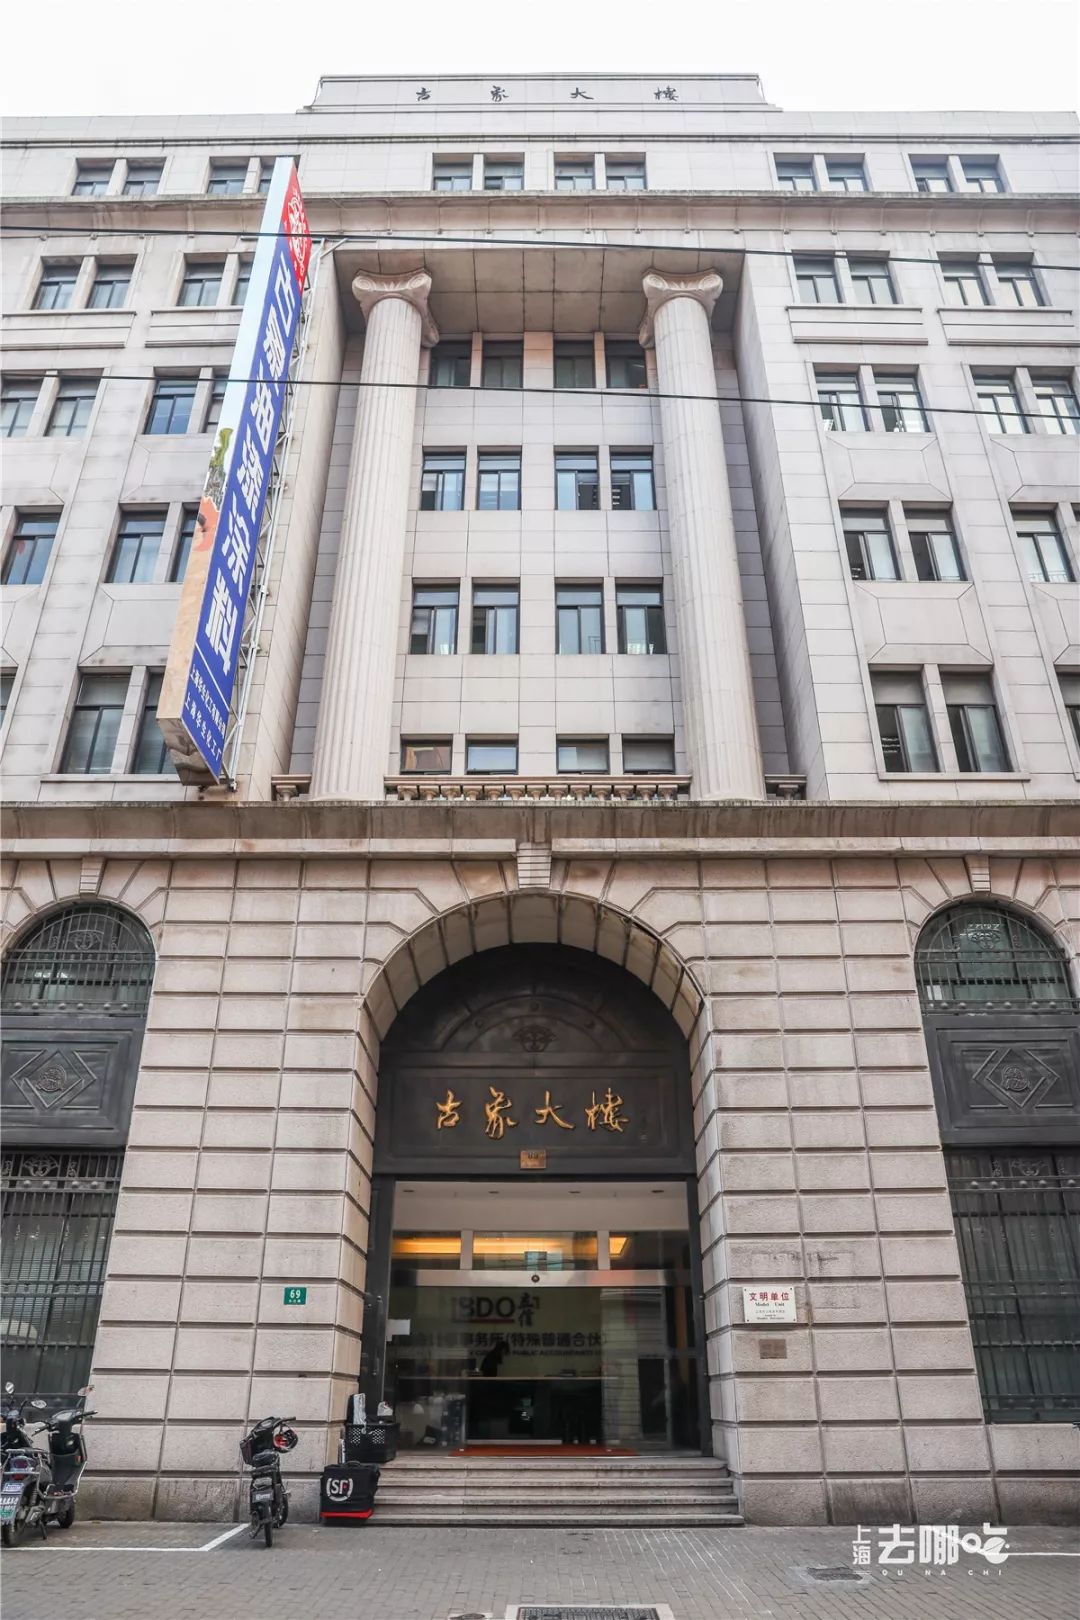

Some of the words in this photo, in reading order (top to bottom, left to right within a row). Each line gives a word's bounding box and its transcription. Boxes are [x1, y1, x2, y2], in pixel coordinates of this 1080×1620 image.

[205, 252, 295, 676] 古象油漆涂料
[290, 1289, 301, 1299] 69
[749, 1292, 789, 1301] 文明单位
